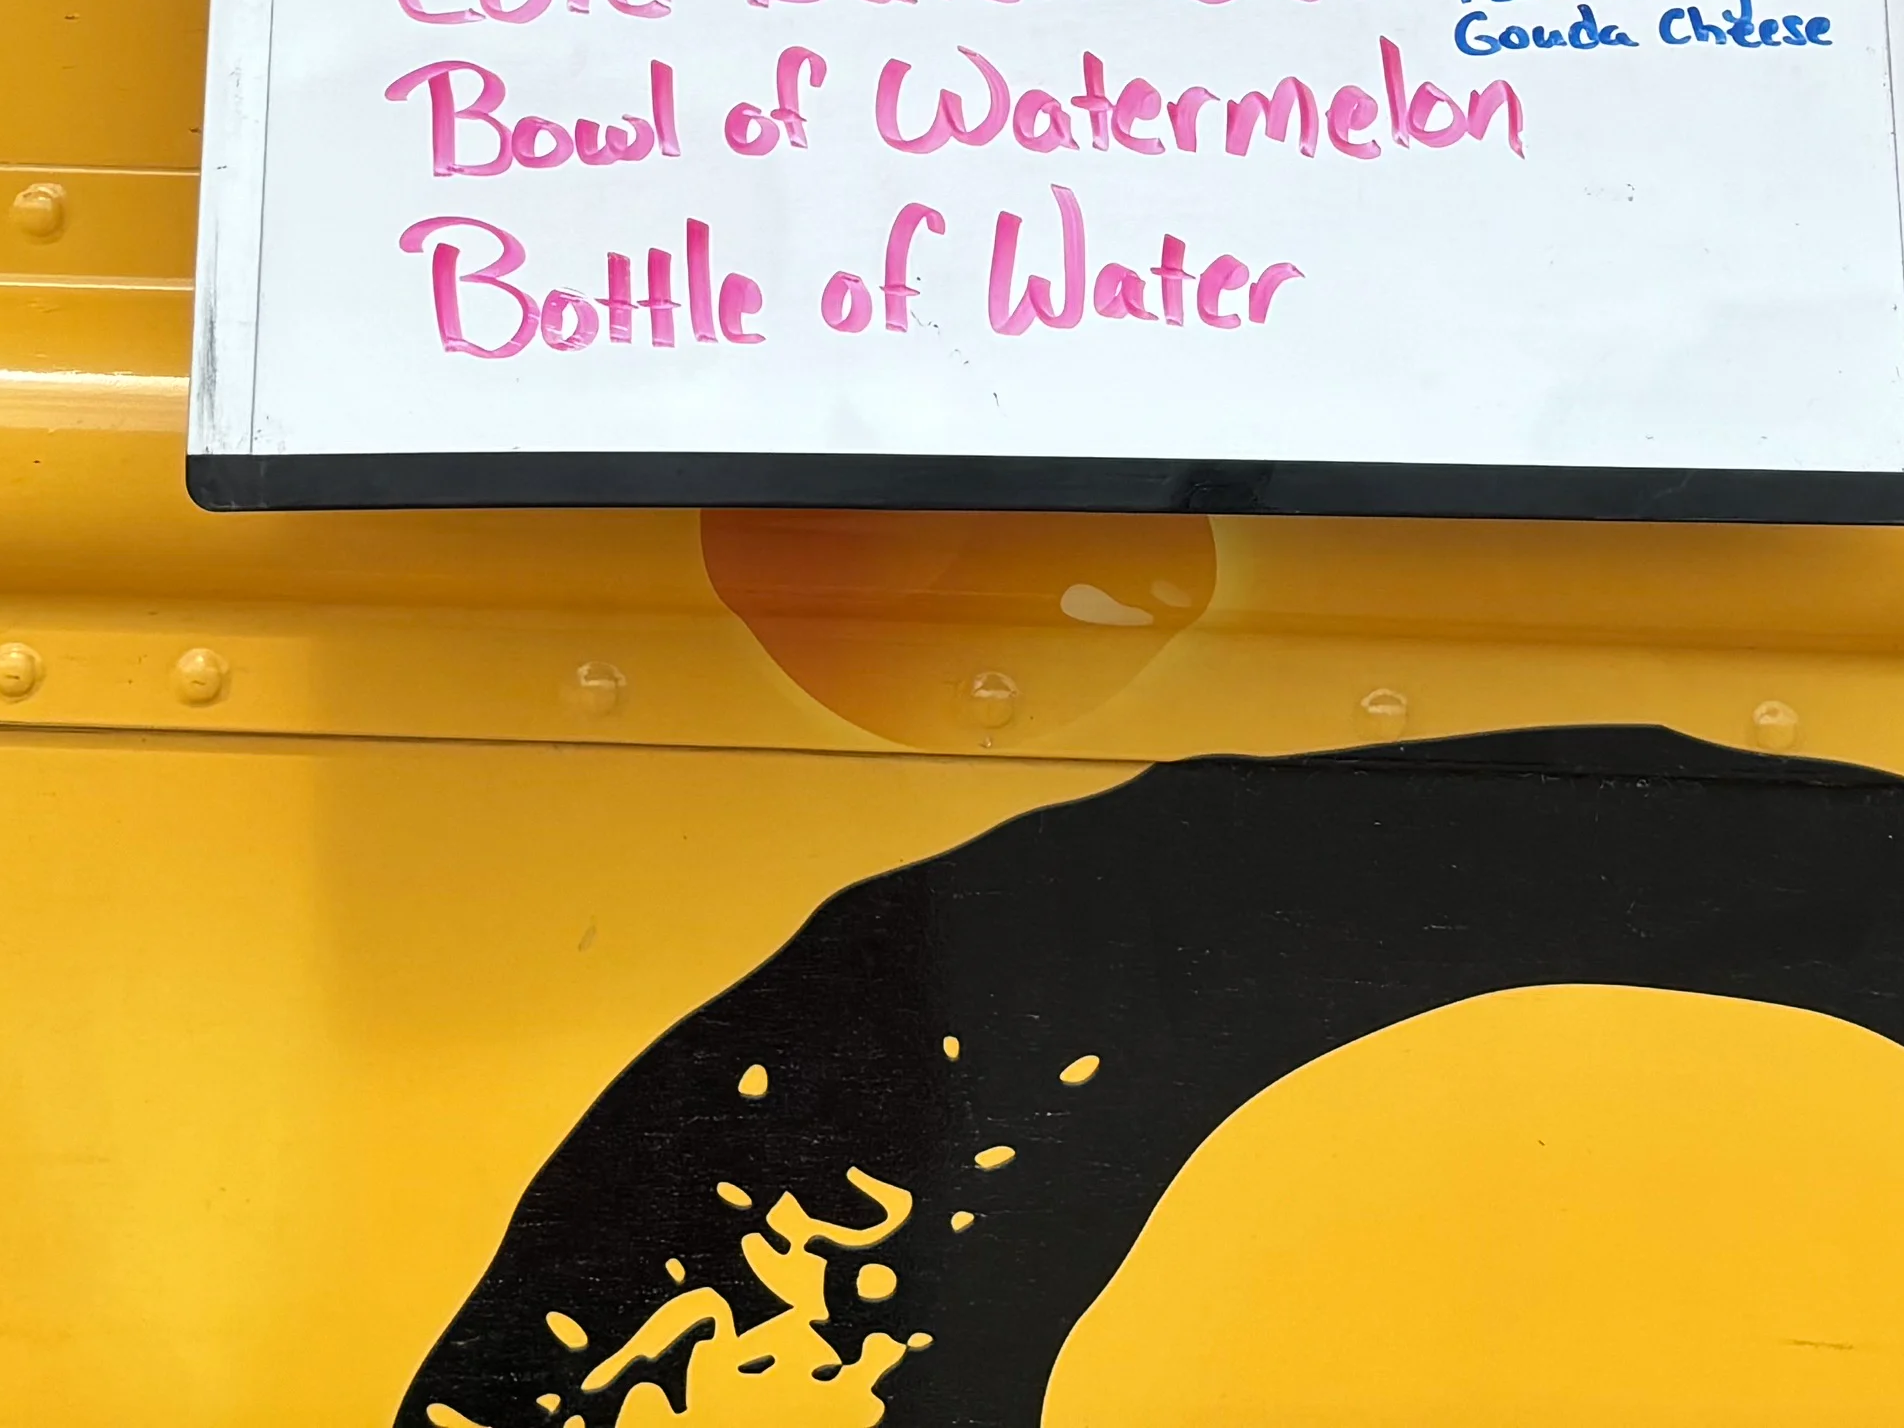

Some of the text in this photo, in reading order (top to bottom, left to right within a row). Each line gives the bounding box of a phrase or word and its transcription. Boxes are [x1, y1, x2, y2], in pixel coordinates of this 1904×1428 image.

[1454, 4, 1834, 56] Gouda Cheese
[385, 36, 1525, 177] Bowl of Watermelon
[398, 184, 1305, 359] Bottle of Water
